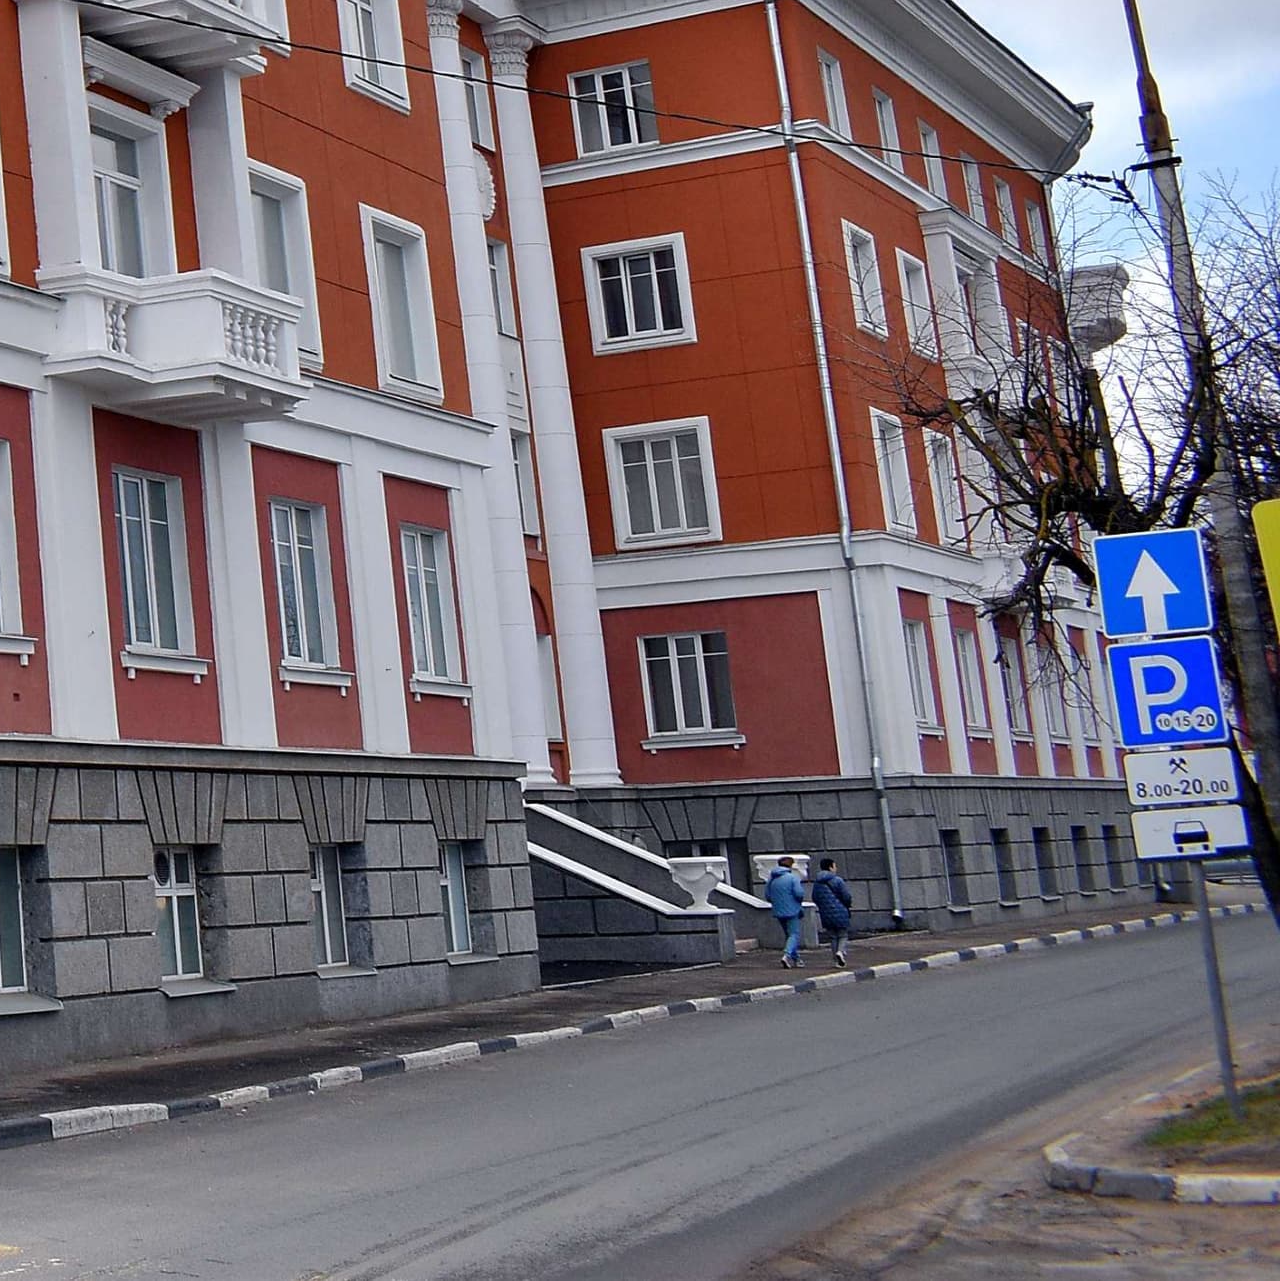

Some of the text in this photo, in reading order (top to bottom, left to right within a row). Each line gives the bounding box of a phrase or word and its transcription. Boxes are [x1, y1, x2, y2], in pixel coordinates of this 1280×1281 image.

[1129, 655, 1188, 735] P
[1157, 714, 1215, 727] 10 15 20
